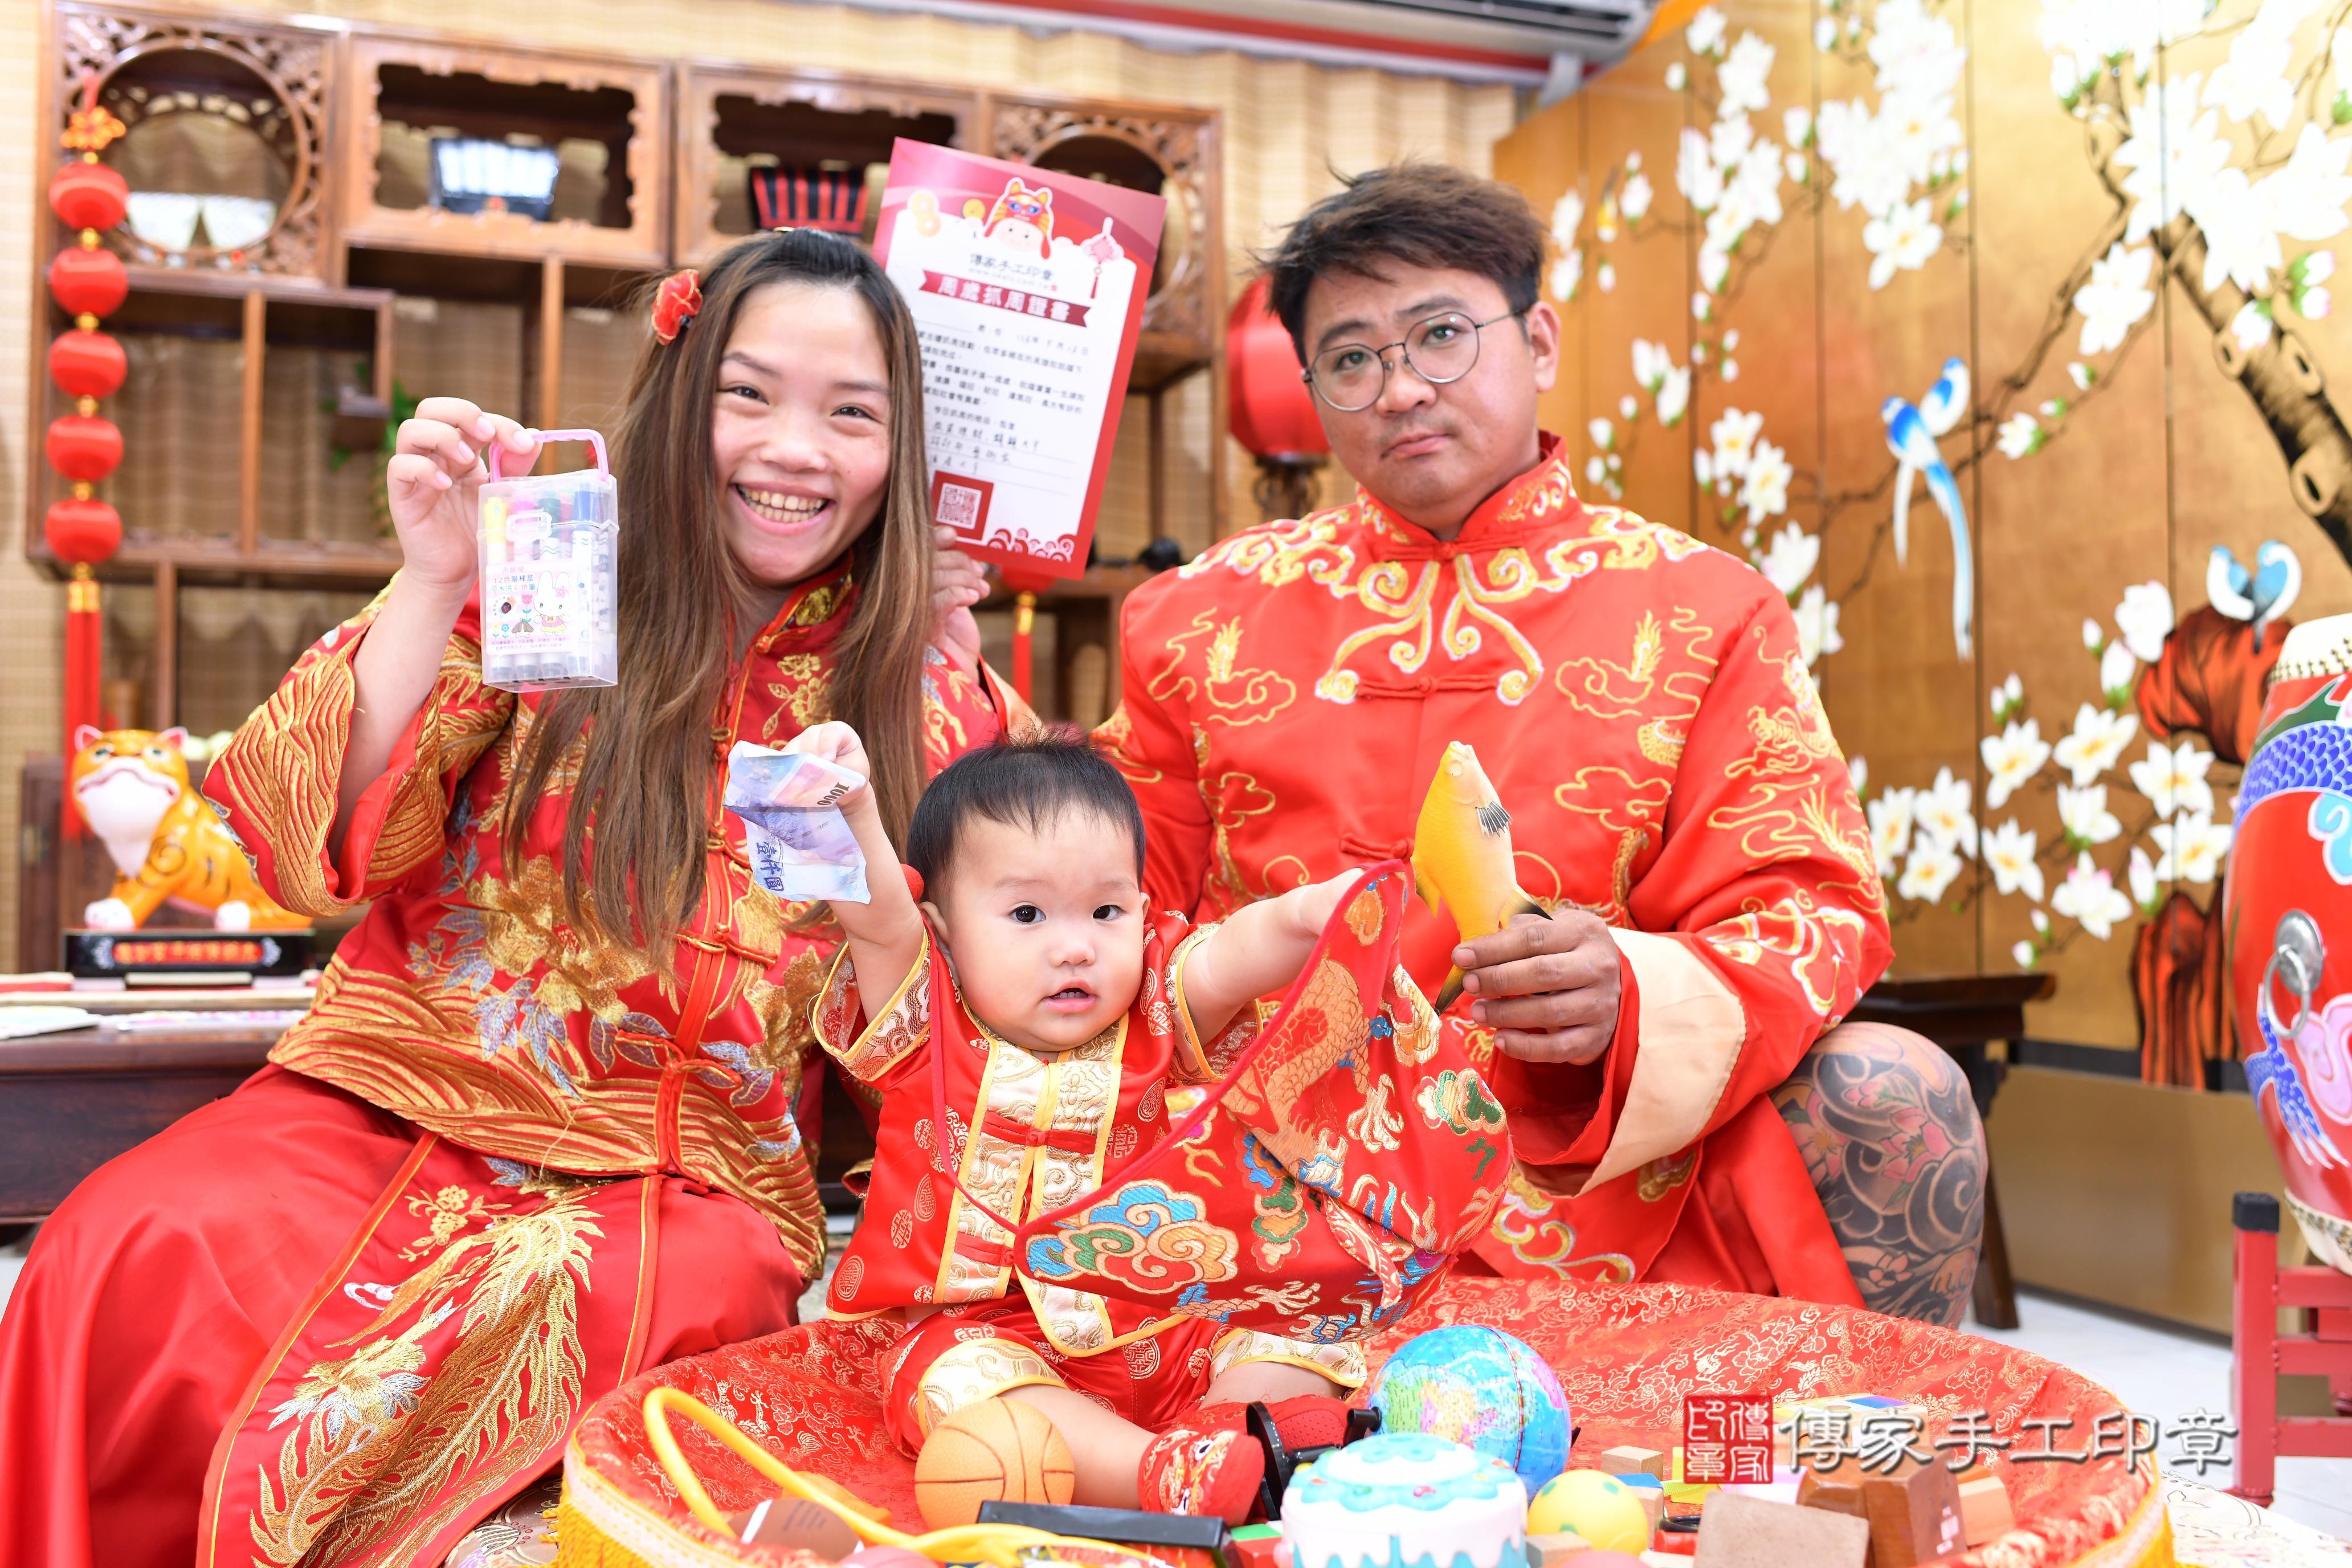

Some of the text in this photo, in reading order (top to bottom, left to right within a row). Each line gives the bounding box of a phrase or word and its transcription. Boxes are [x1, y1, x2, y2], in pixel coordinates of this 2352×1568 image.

[938, 275, 1071, 322] 周歲抓周證書
[817, 782, 850, 805] 1000
[756, 841, 785, 891] 壹仟圓
